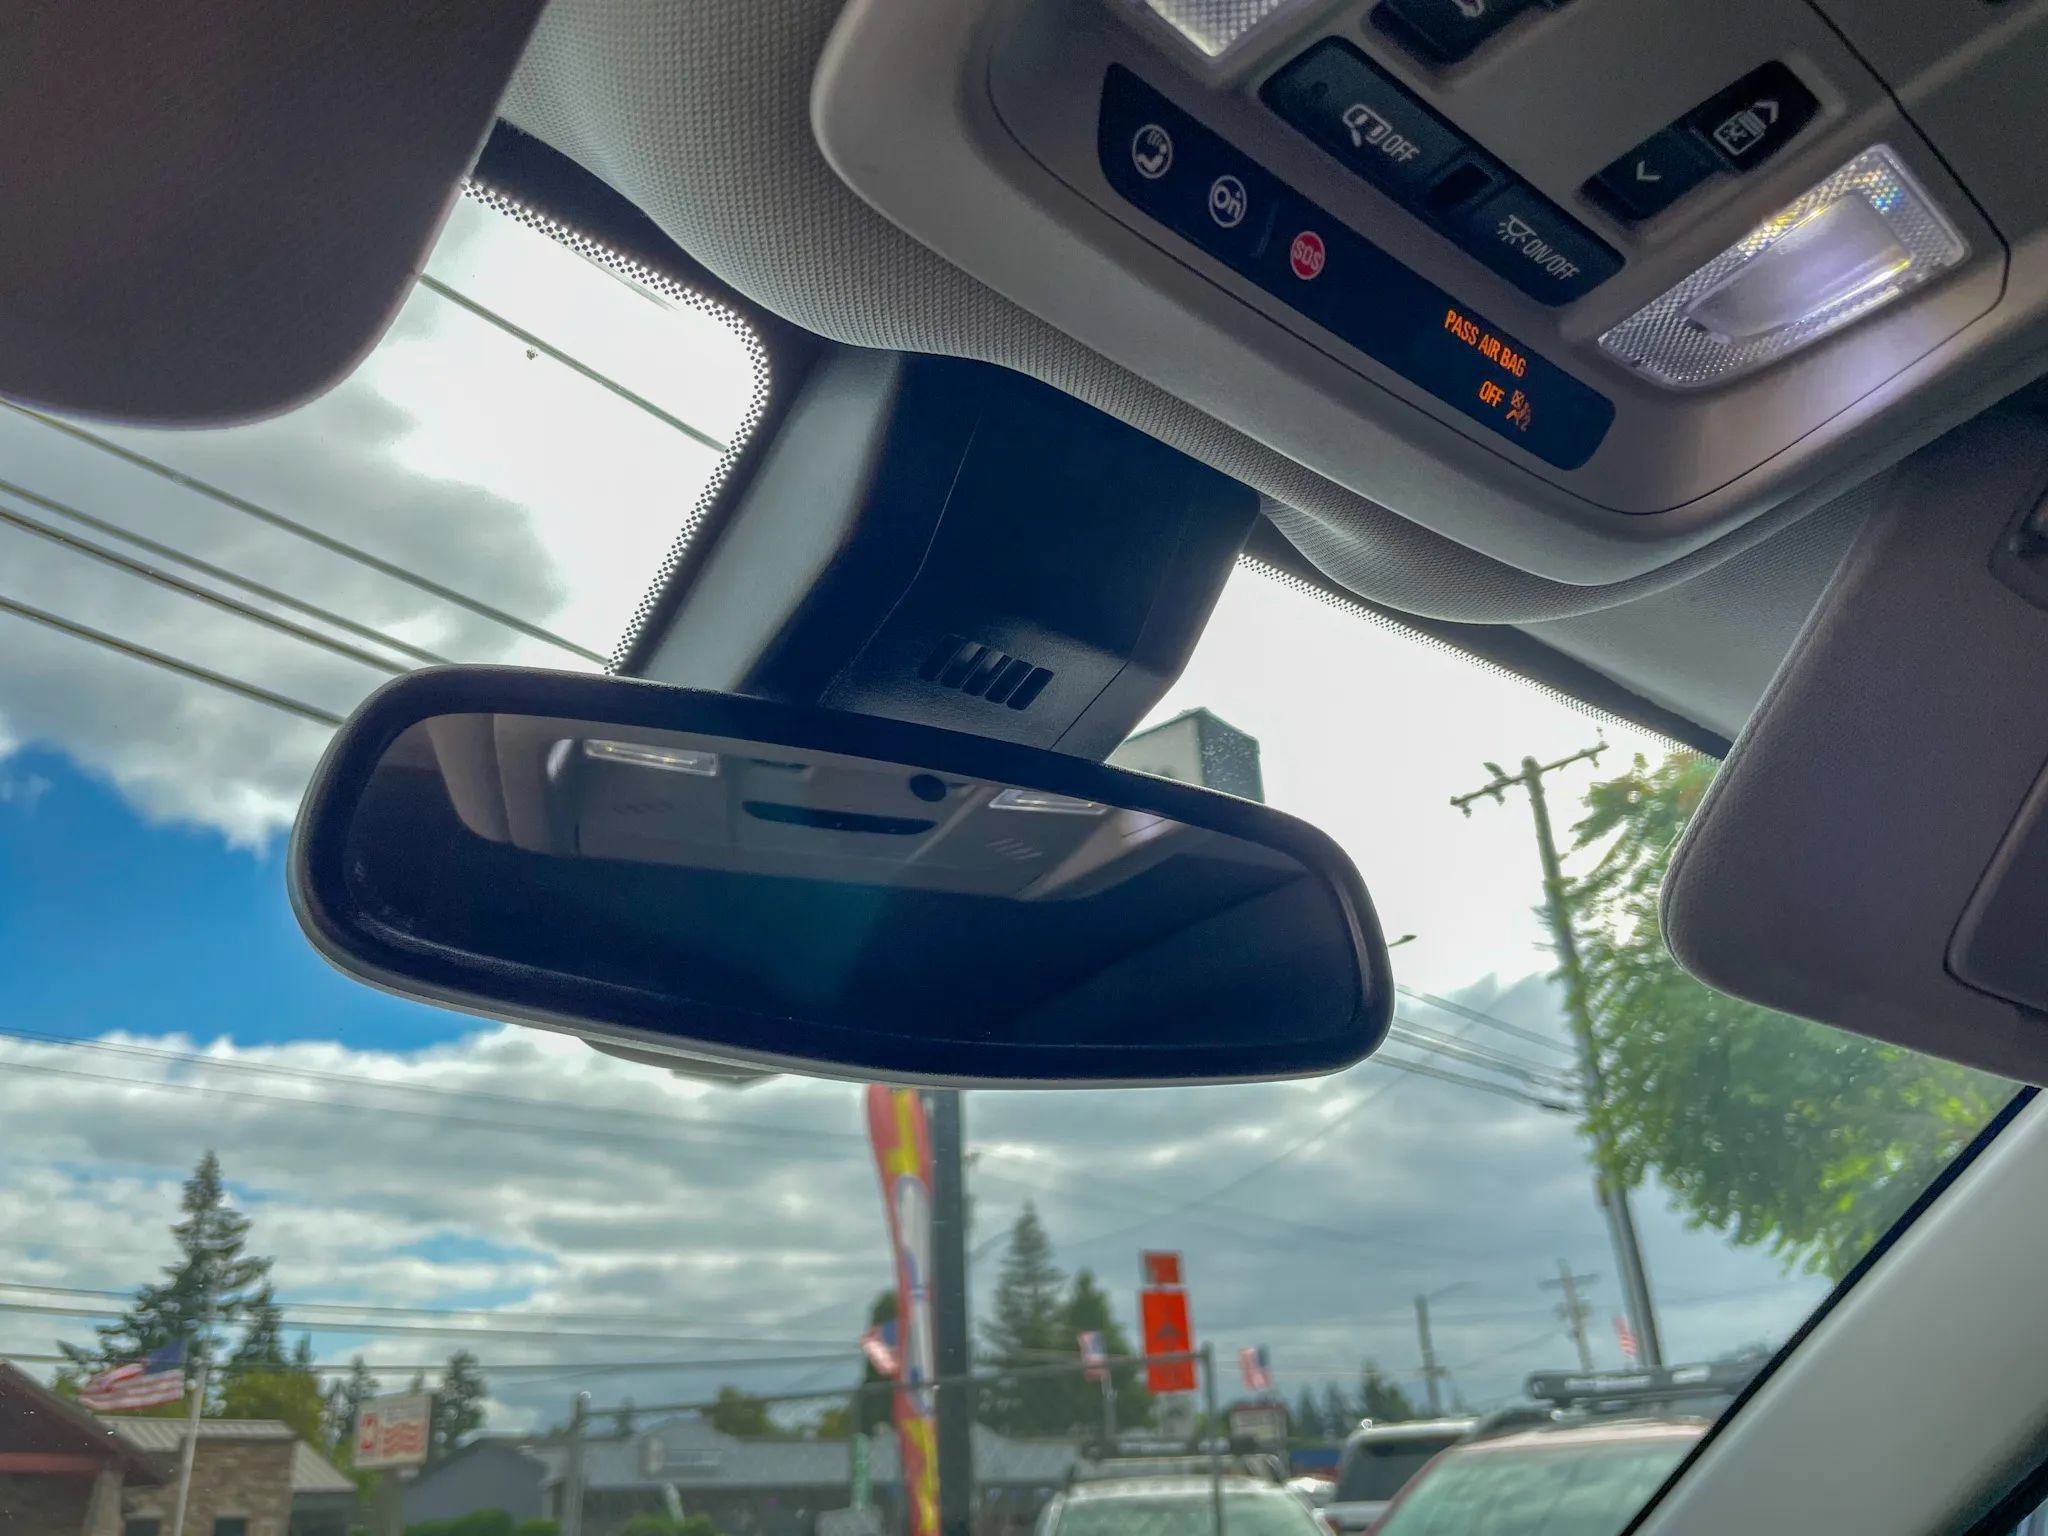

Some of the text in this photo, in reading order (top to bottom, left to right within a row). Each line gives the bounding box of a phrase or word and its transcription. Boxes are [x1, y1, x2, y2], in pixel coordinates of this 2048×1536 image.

[1382, 134, 1420, 162] OFF
[1293, 240, 1322, 271] SOS
[1523, 239, 1580, 280] ON/OFF
[1444, 309, 1527, 377] PASS AIR BAG
[1479, 380, 1505, 407] OFF
